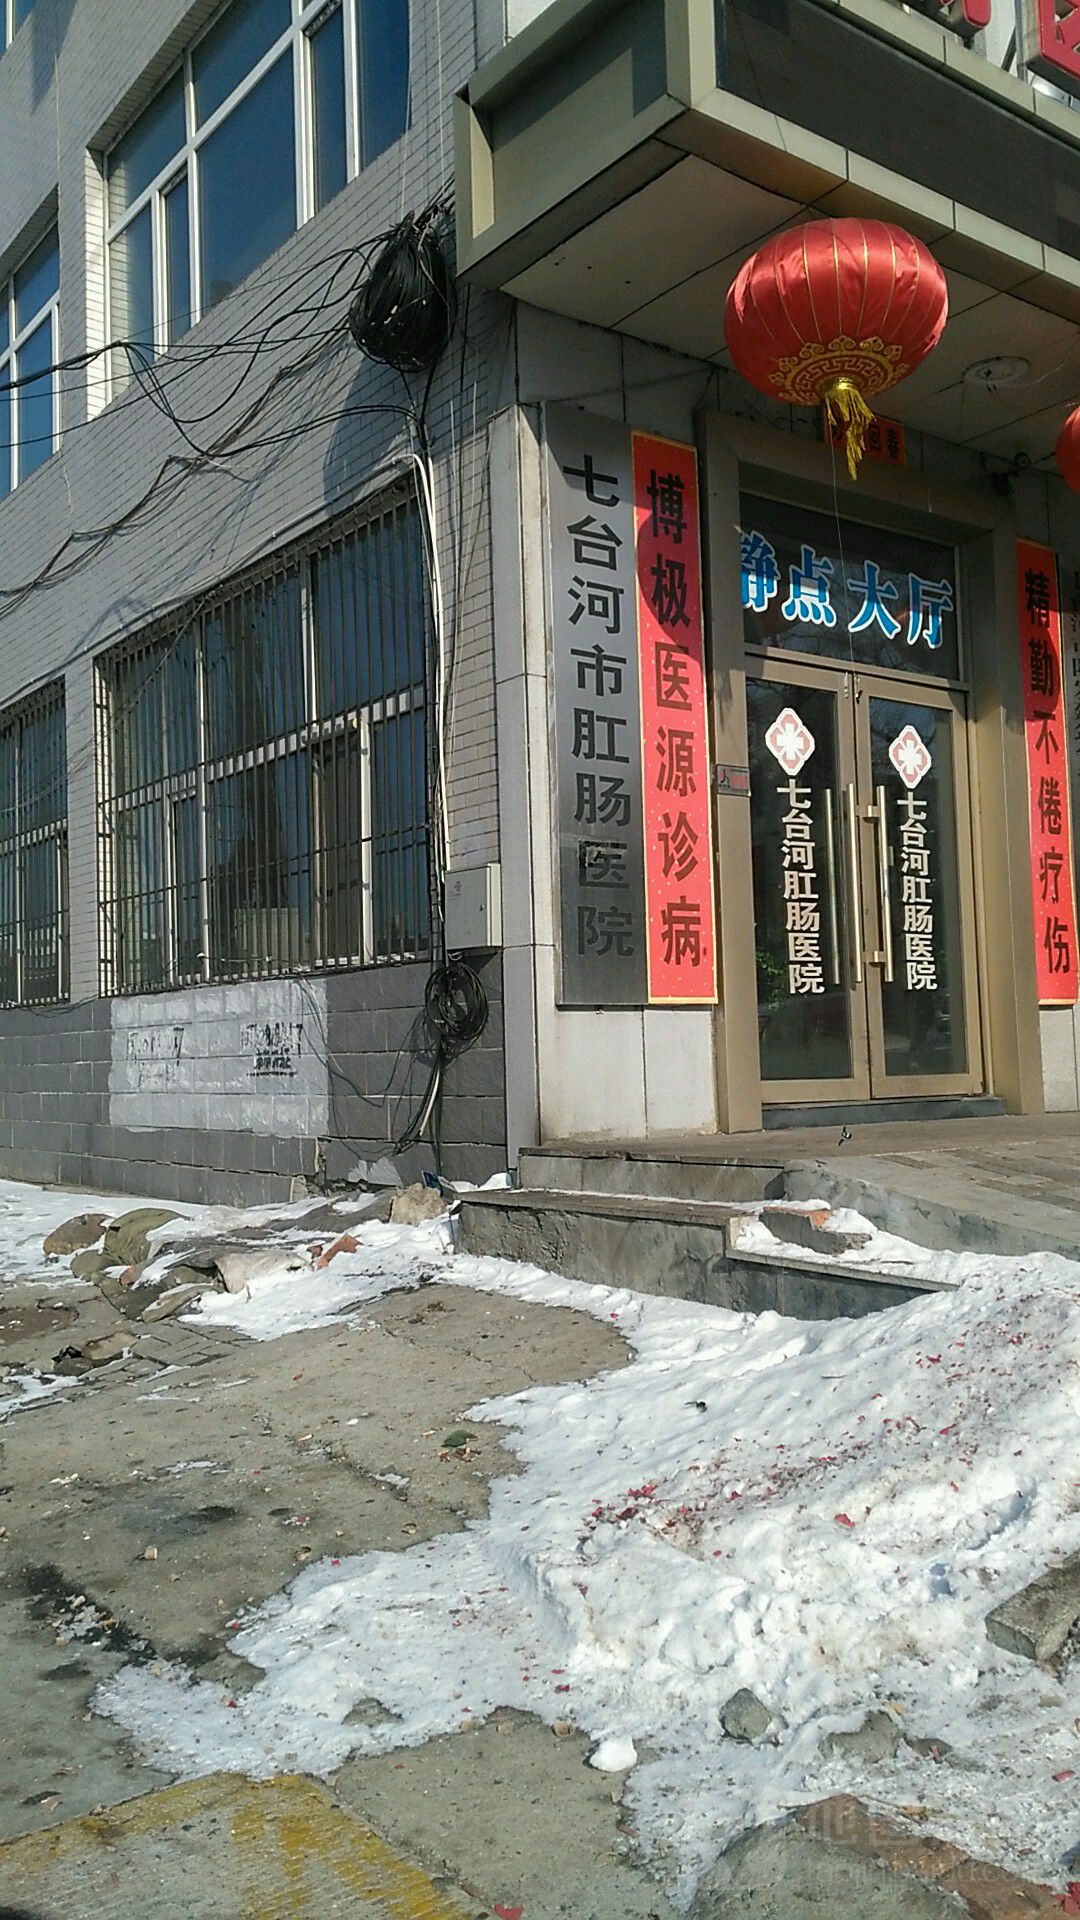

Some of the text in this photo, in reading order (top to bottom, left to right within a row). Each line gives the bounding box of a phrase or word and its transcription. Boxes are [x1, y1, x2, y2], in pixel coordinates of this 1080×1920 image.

[563, 454, 634, 957] 七台河市肛肠医院
[647, 469, 702, 967] 博极医源诊病
[740, 530, 953, 649] 静点大厅
[776, 779, 825, 994] 七台河肛肠医院
[897, 791, 938, 991] 七台河肛肠医院
[1025, 568, 1070, 975] 精勤不倦疗伤
